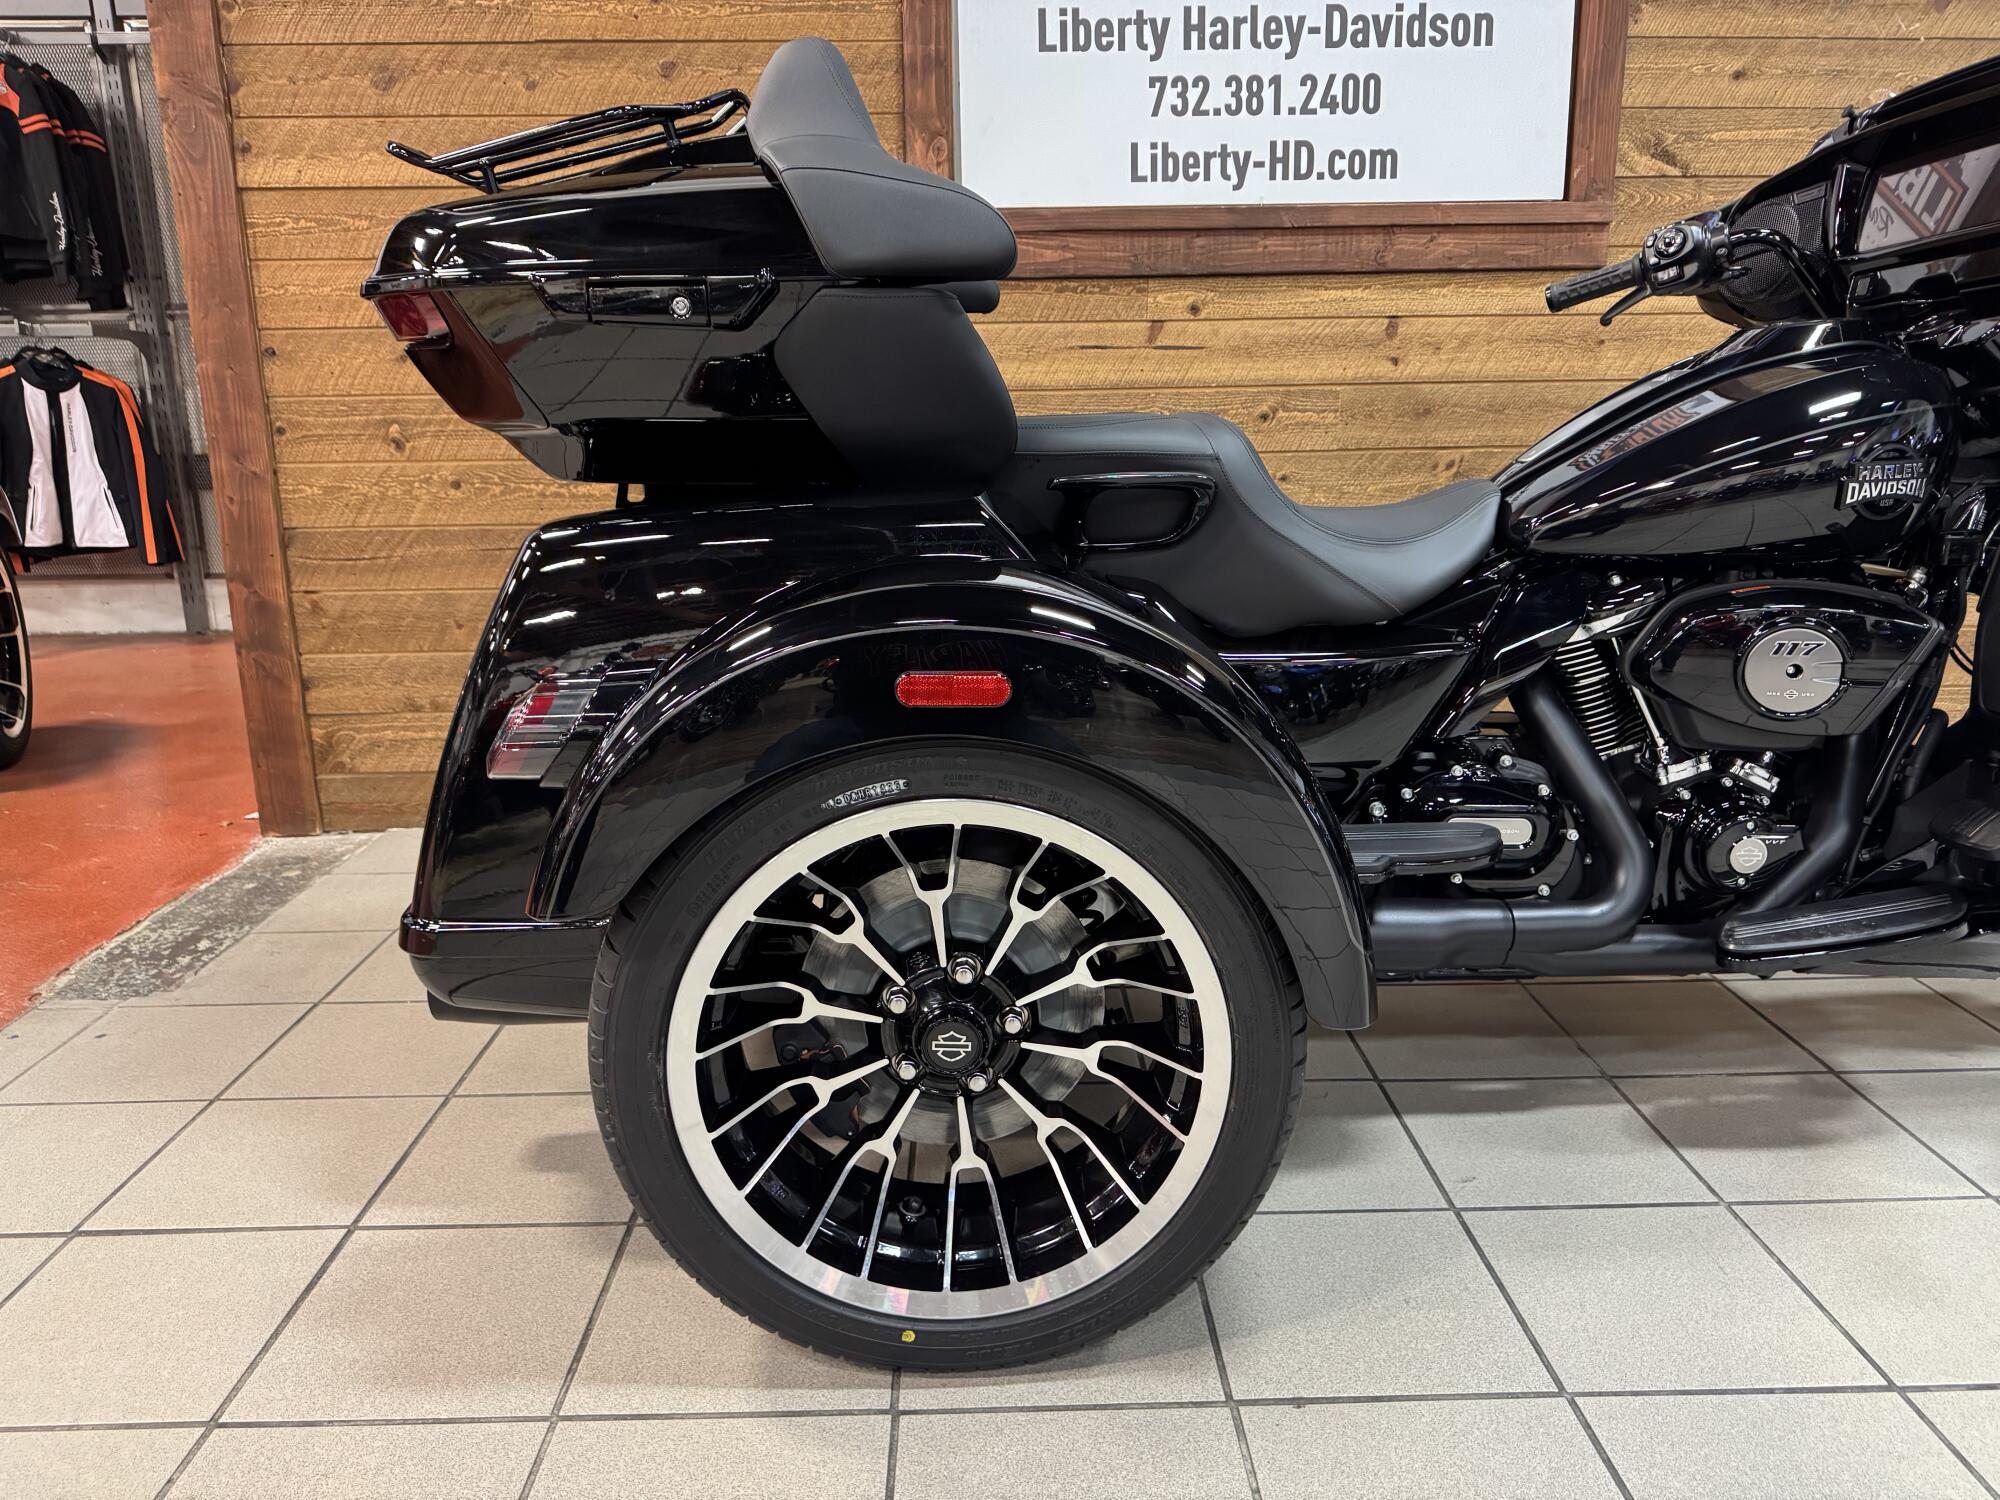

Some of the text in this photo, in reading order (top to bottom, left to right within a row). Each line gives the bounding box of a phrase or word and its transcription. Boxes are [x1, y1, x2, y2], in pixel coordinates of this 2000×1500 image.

[1037, 2, 1494, 62] Liberty Harley-Davidson
[1148, 72, 1382, 118] 732.381.2400
[1130, 139, 1398, 192] Liberty-HD.com
[1845, 477, 1928, 505] DAVIDSON
[1769, 640, 1827, 657] 117
